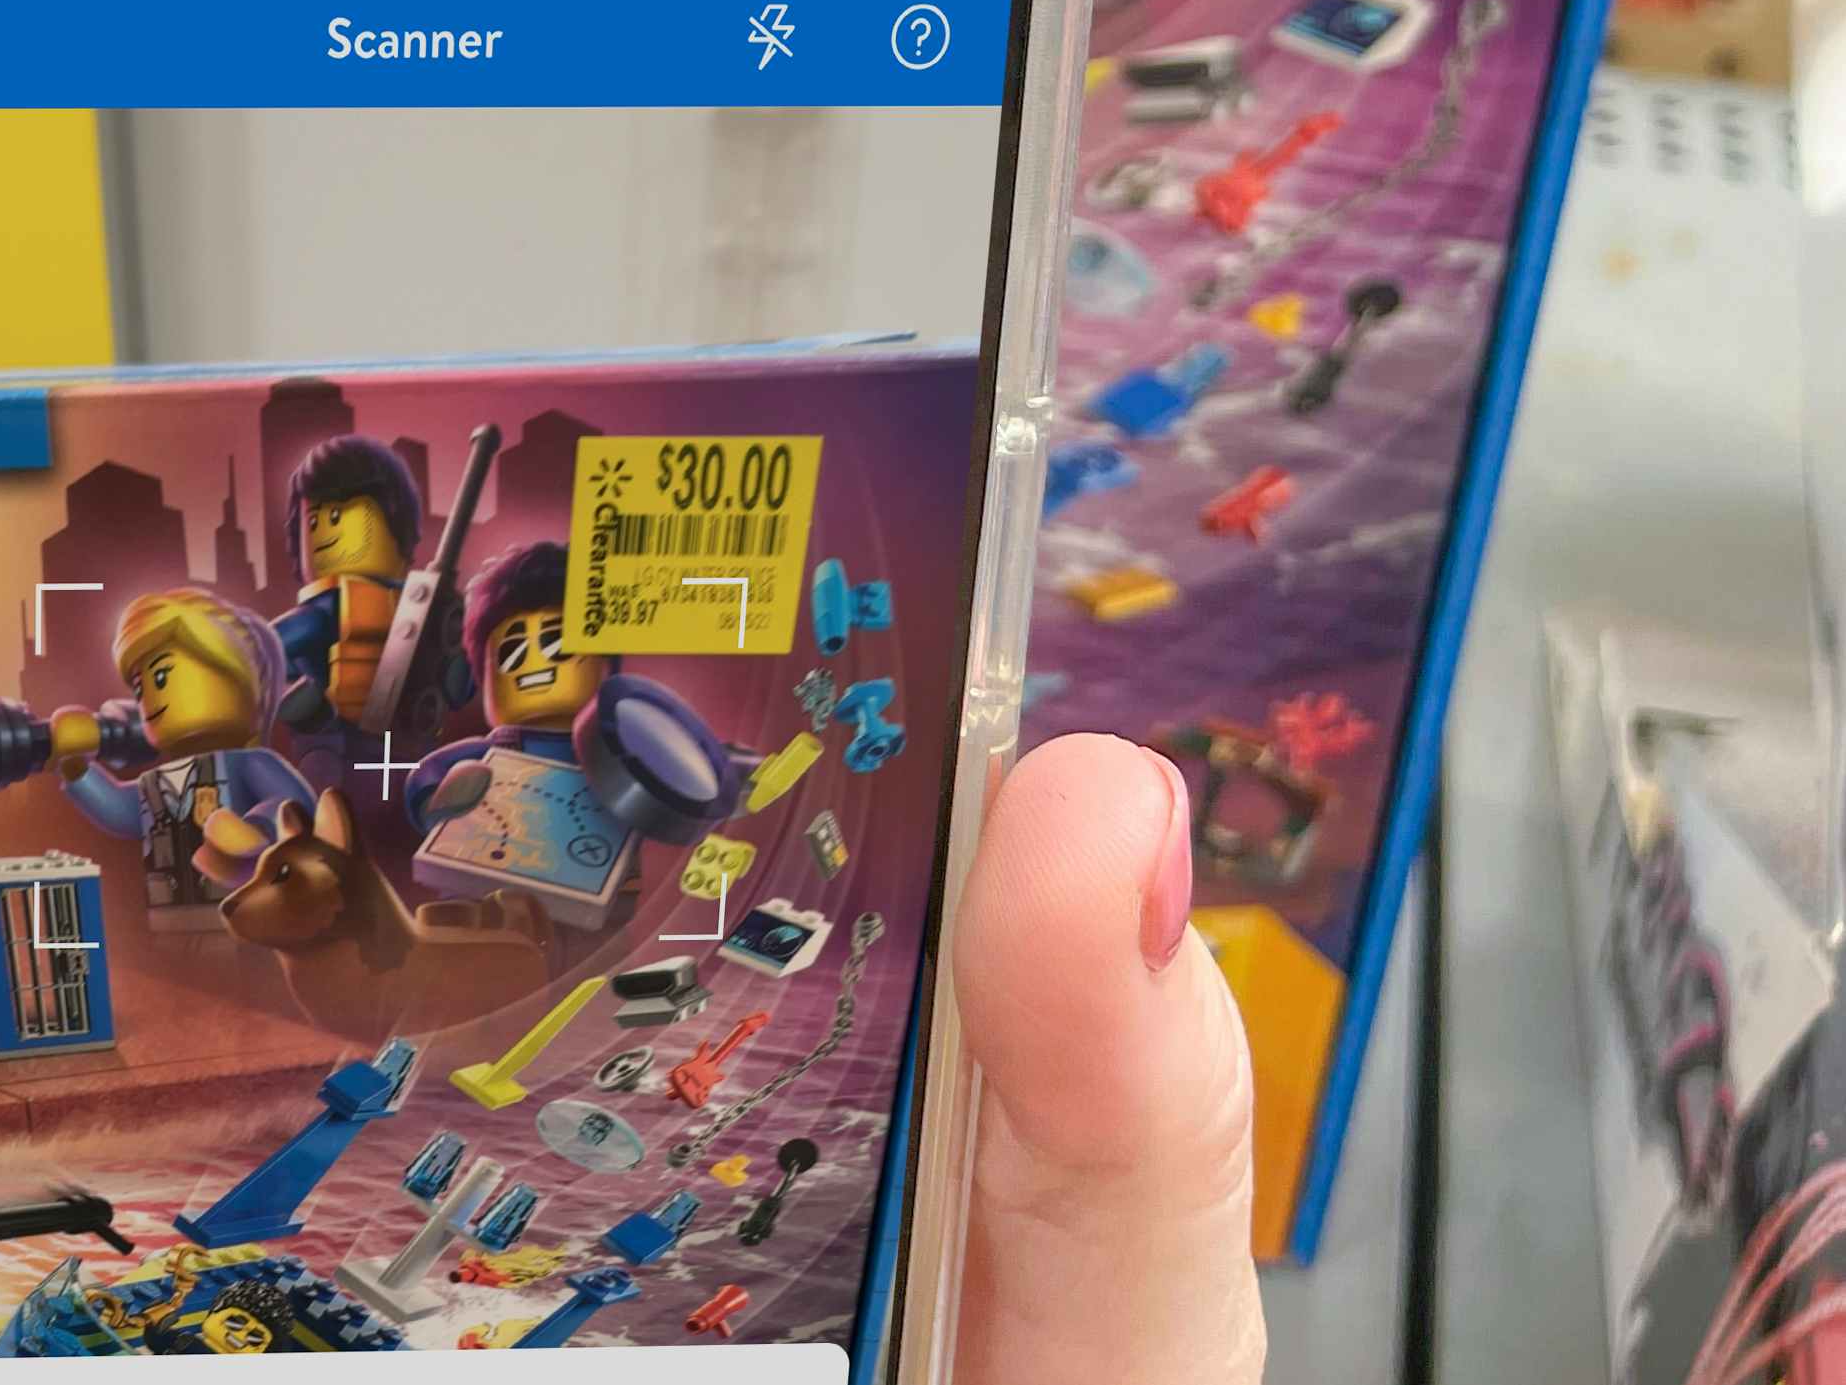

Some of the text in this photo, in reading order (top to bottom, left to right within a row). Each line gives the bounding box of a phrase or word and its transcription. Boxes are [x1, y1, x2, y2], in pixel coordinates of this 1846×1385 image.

[326, 16, 504, 61] Scanner
[656, 443, 794, 510] $30.00
[581, 502, 620, 638] Clearance
